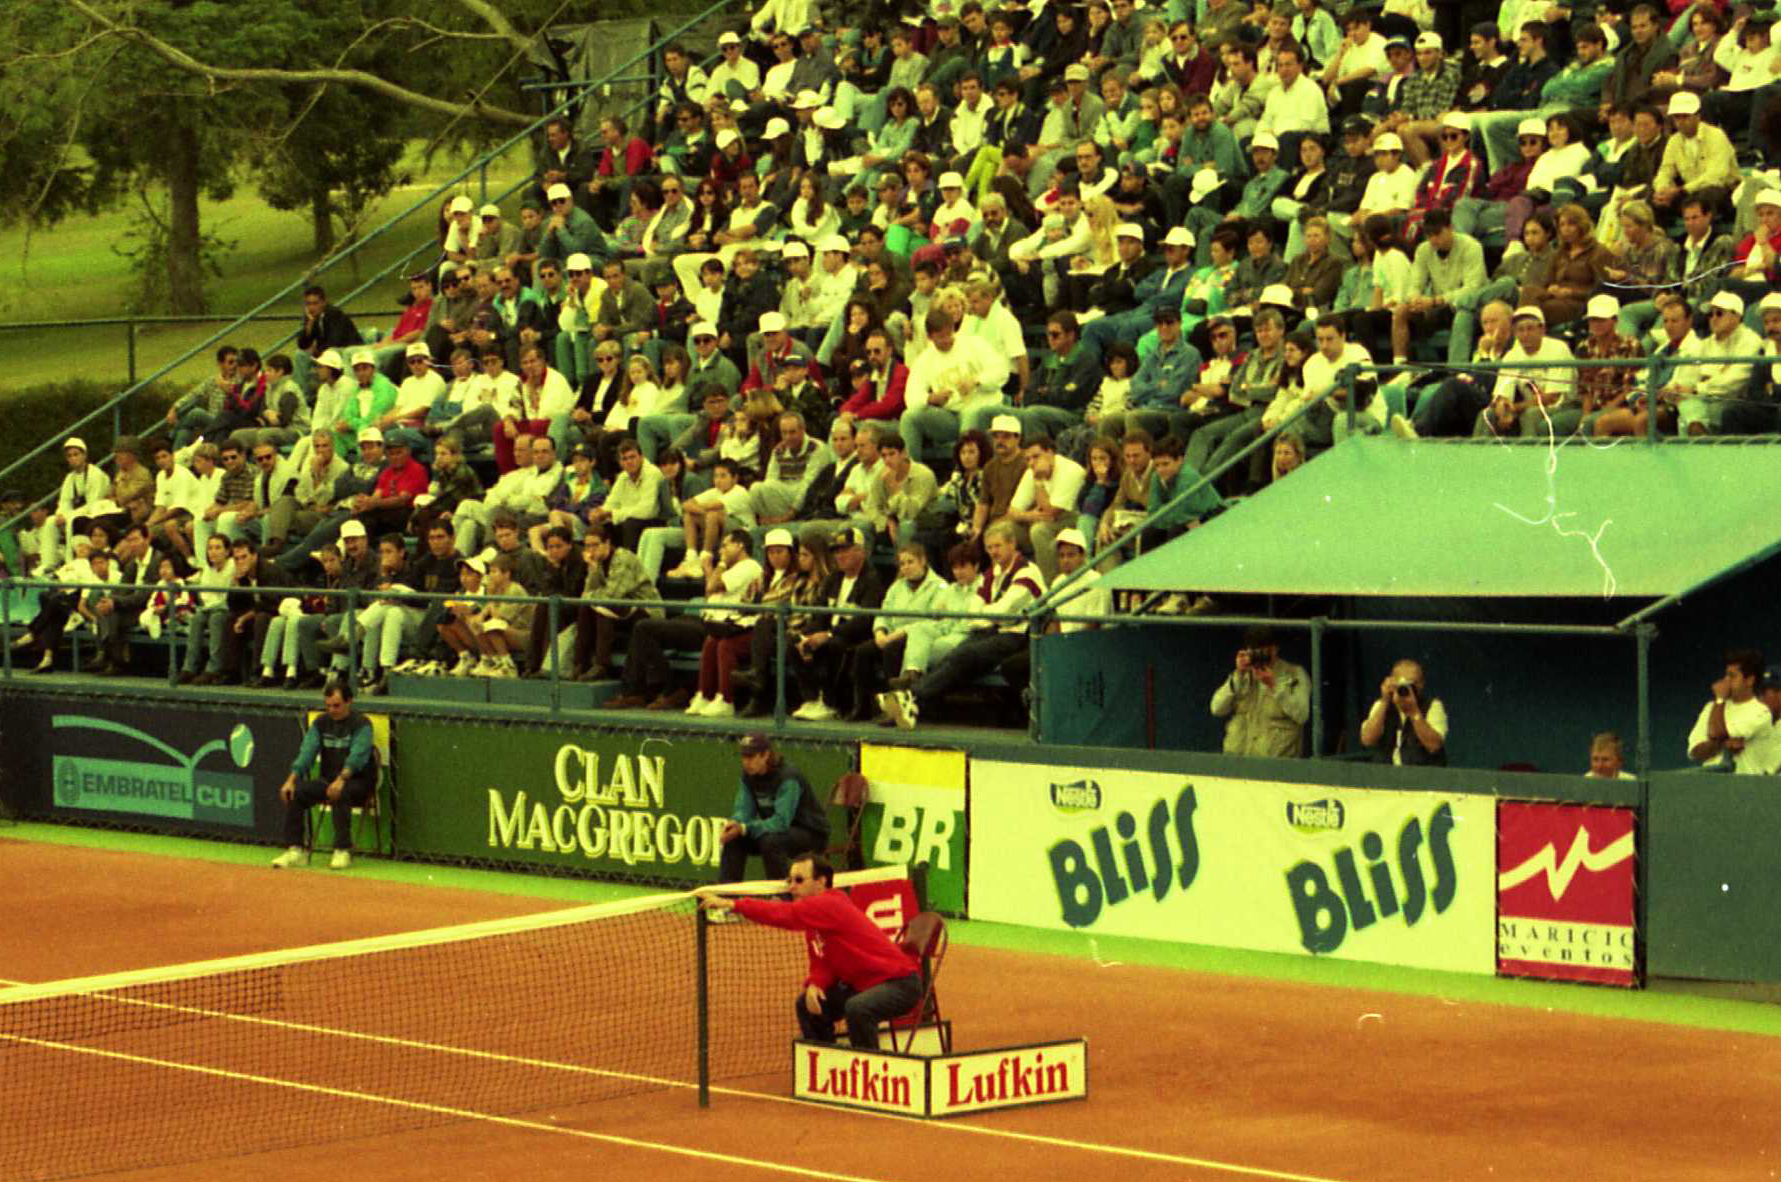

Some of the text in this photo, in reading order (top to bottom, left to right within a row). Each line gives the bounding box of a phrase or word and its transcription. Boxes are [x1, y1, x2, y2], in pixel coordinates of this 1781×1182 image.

[82, 773, 251, 810] EMBRATEL CUP
[555, 743, 666, 808] CLAN
[872, 803, 956, 870] BR
[1499, 944, 1632, 964] eventos
[807, 1051, 911, 1107] Lufkin
[947, 1052, 1070, 1107] Lufkin
